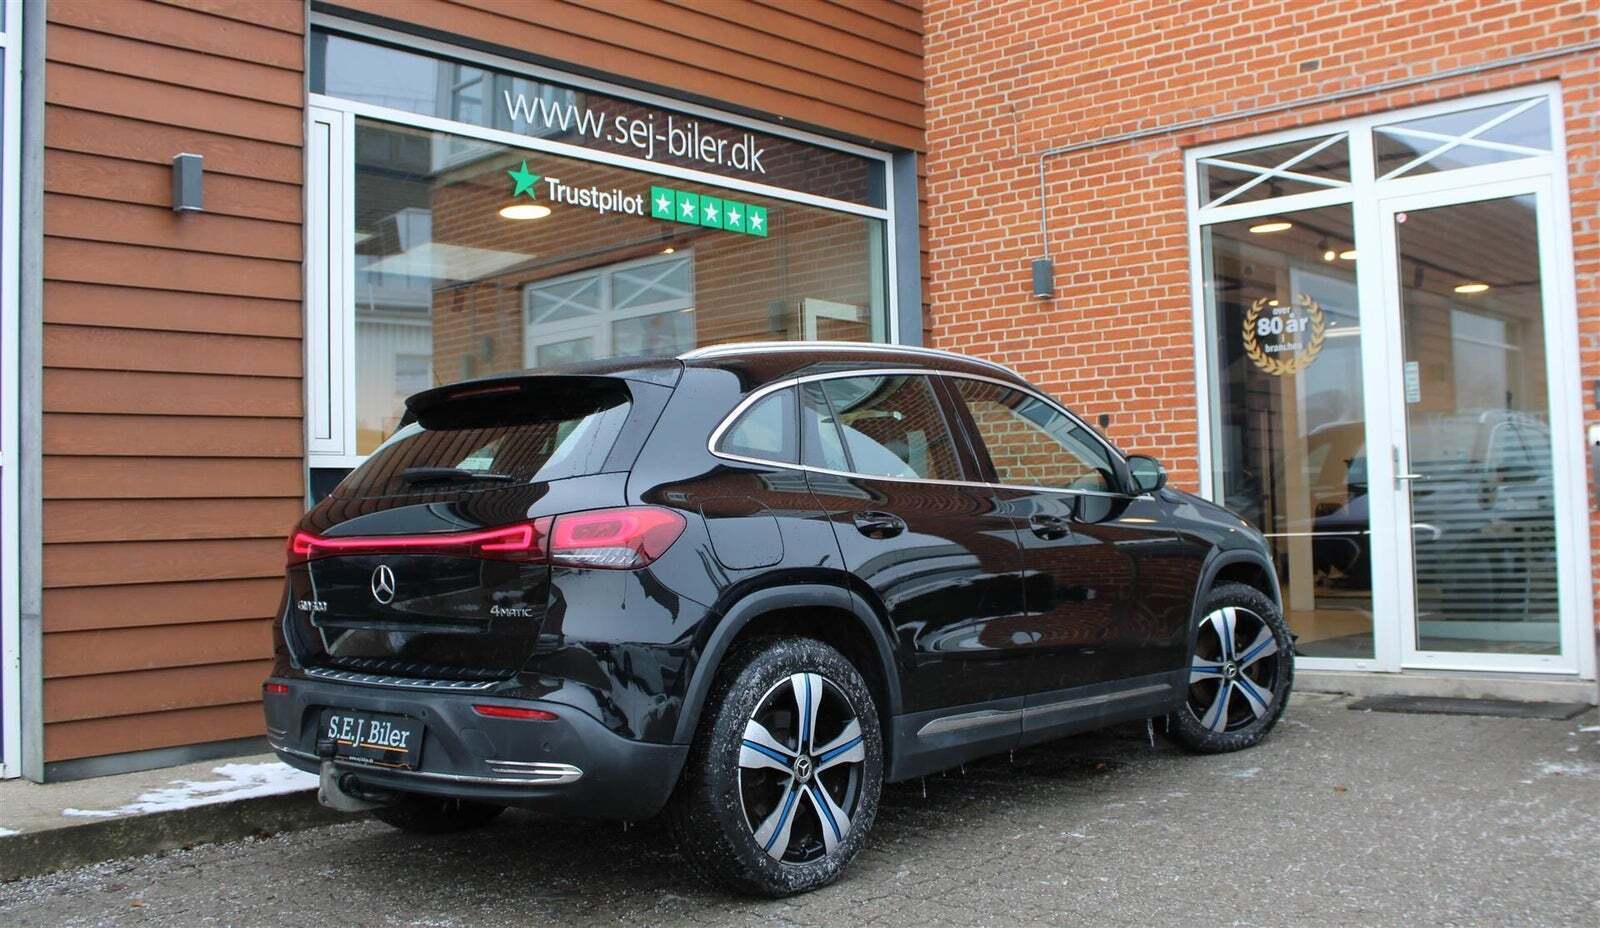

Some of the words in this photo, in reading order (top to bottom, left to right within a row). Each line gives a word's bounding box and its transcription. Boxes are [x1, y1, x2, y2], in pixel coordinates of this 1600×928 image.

[504, 90, 766, 174] www.sej-biler.dk
[545, 176, 644, 216] Trustpilot
[1257, 316, 1283, 337] 80
[1286, 312, 1309, 333] år
[490, 604, 533, 617] 4MATIC
[327, 715, 365, 748] S.E.J.
[367, 720, 410, 748] Biler
